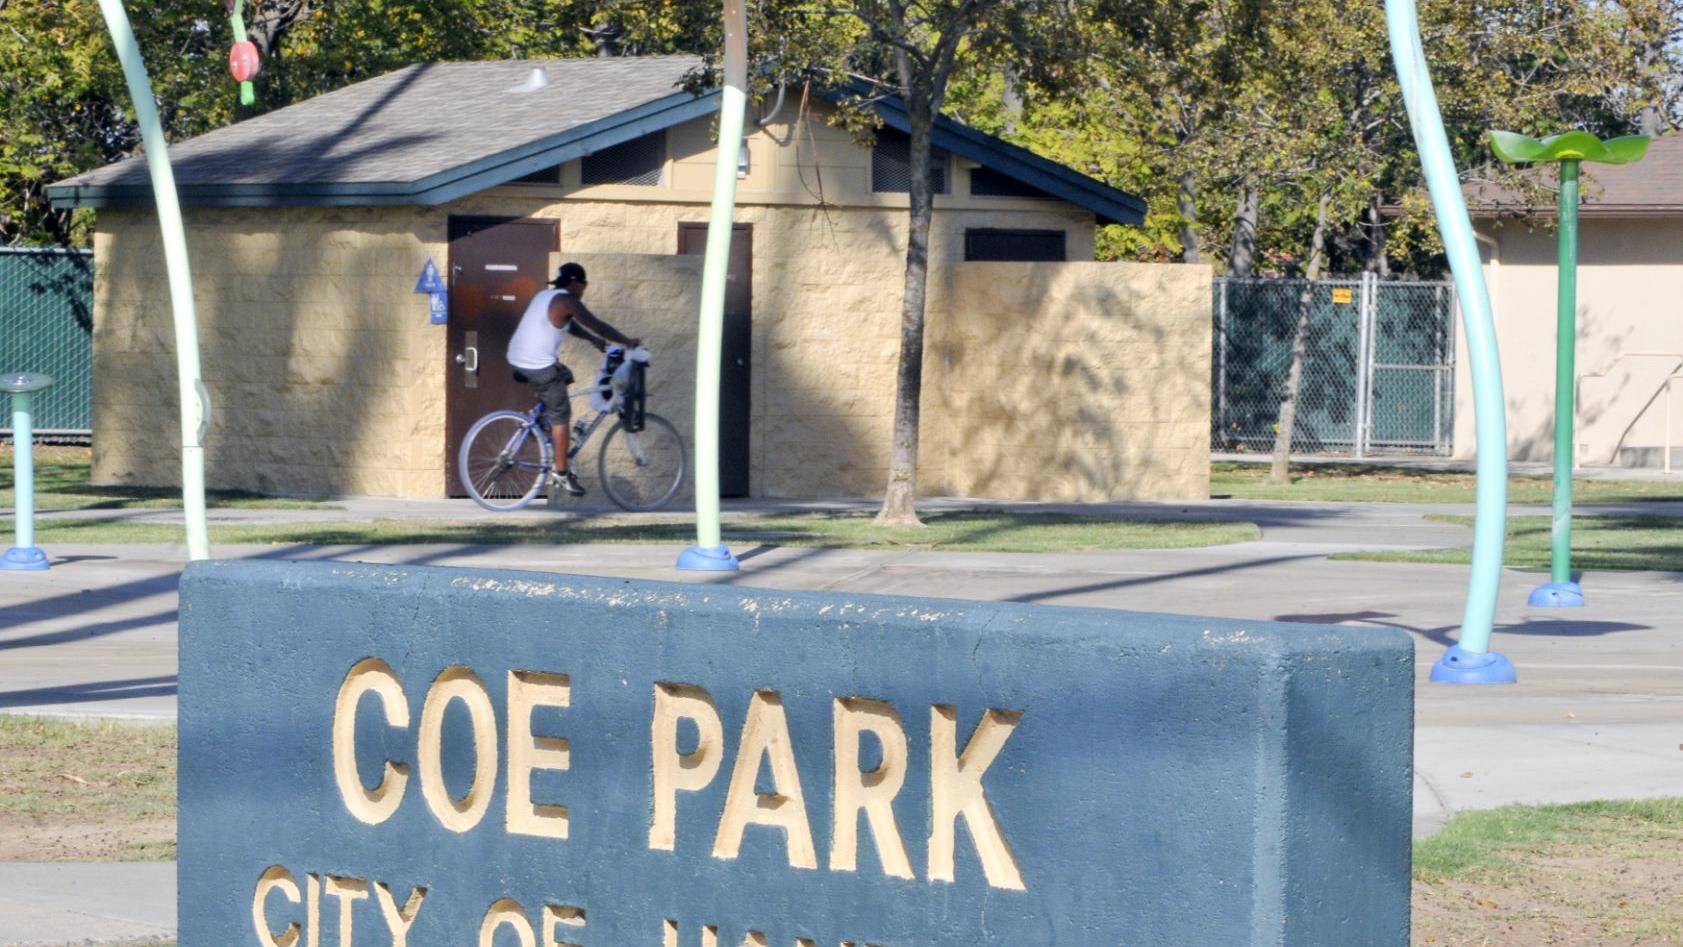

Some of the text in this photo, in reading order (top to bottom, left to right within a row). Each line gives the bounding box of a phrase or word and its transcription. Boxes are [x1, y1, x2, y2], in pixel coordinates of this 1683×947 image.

[333, 656, 1027, 892] COE PARK
[252, 863, 428, 947] CITY
